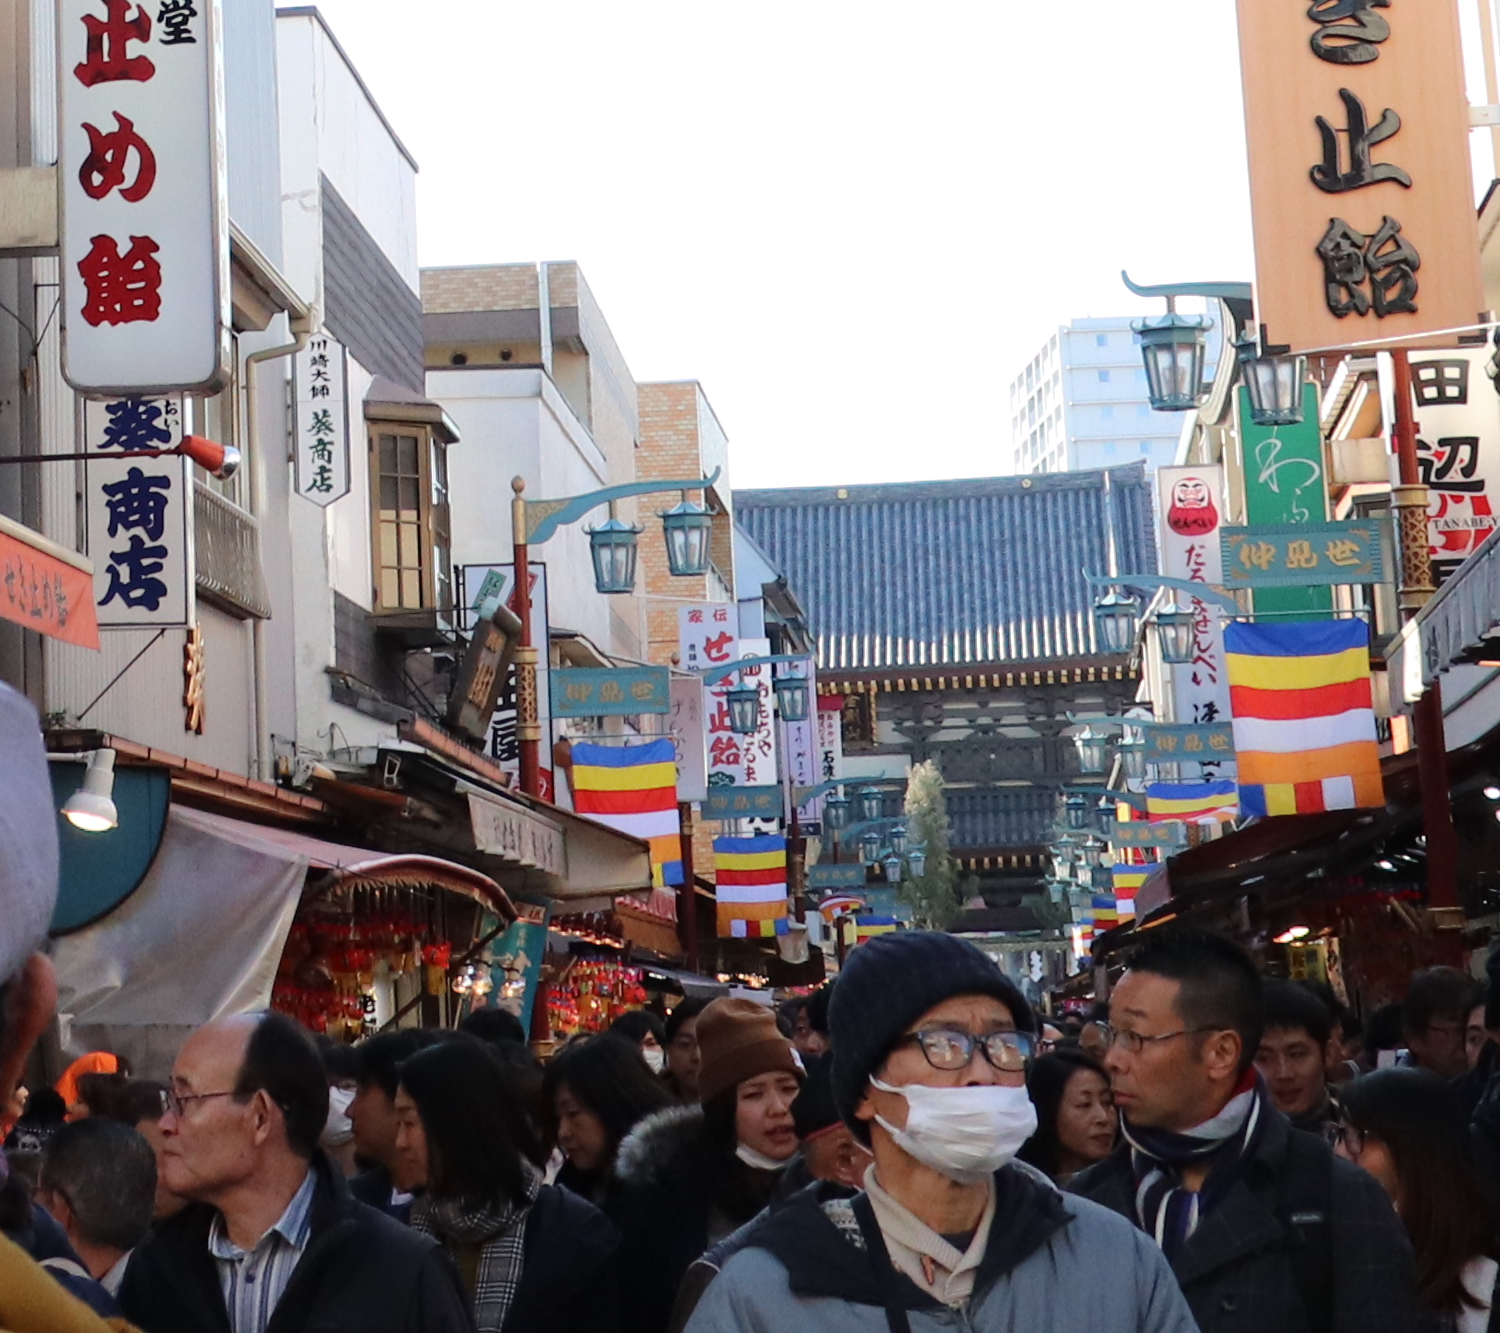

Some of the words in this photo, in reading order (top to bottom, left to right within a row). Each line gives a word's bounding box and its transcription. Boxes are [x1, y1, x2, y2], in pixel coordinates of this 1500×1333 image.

[305, 409, 335, 494] 葵商店
[97, 393, 173, 613] 葵商店
[1239, 538, 1362, 571] 仲見世
[687, 608, 729, 624] 家伝
[743, 733, 758, 783] るま
